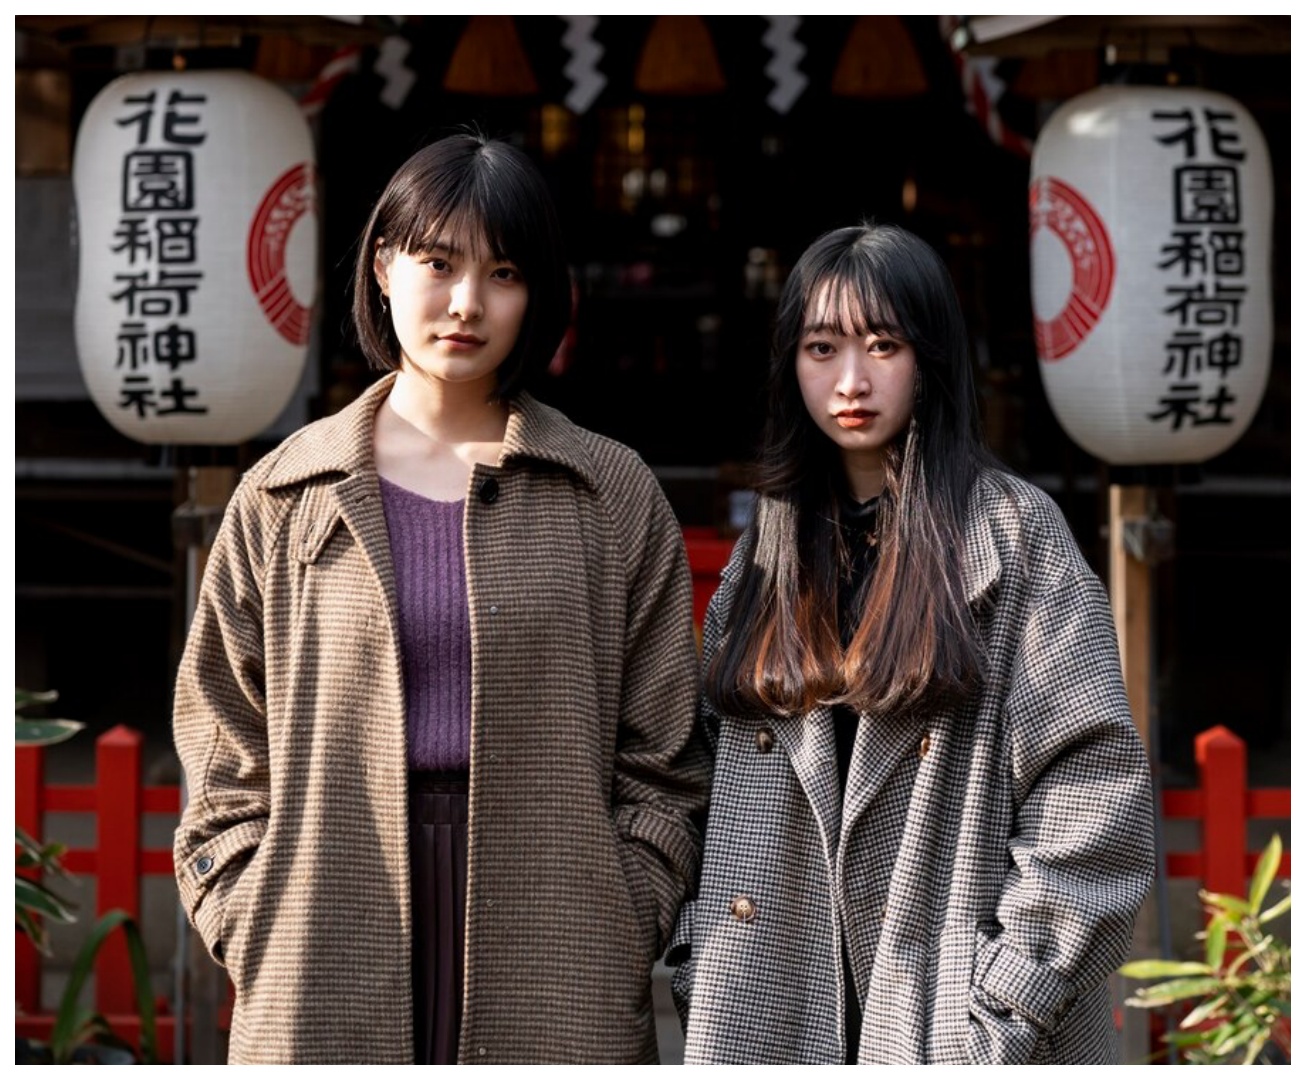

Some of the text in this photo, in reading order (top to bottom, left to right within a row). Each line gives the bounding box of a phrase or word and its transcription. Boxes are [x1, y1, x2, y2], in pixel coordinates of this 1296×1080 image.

[111, 89, 208, 417] 花園稲荷神社
[1148, 107, 1248, 430] 花園稲荷神社
